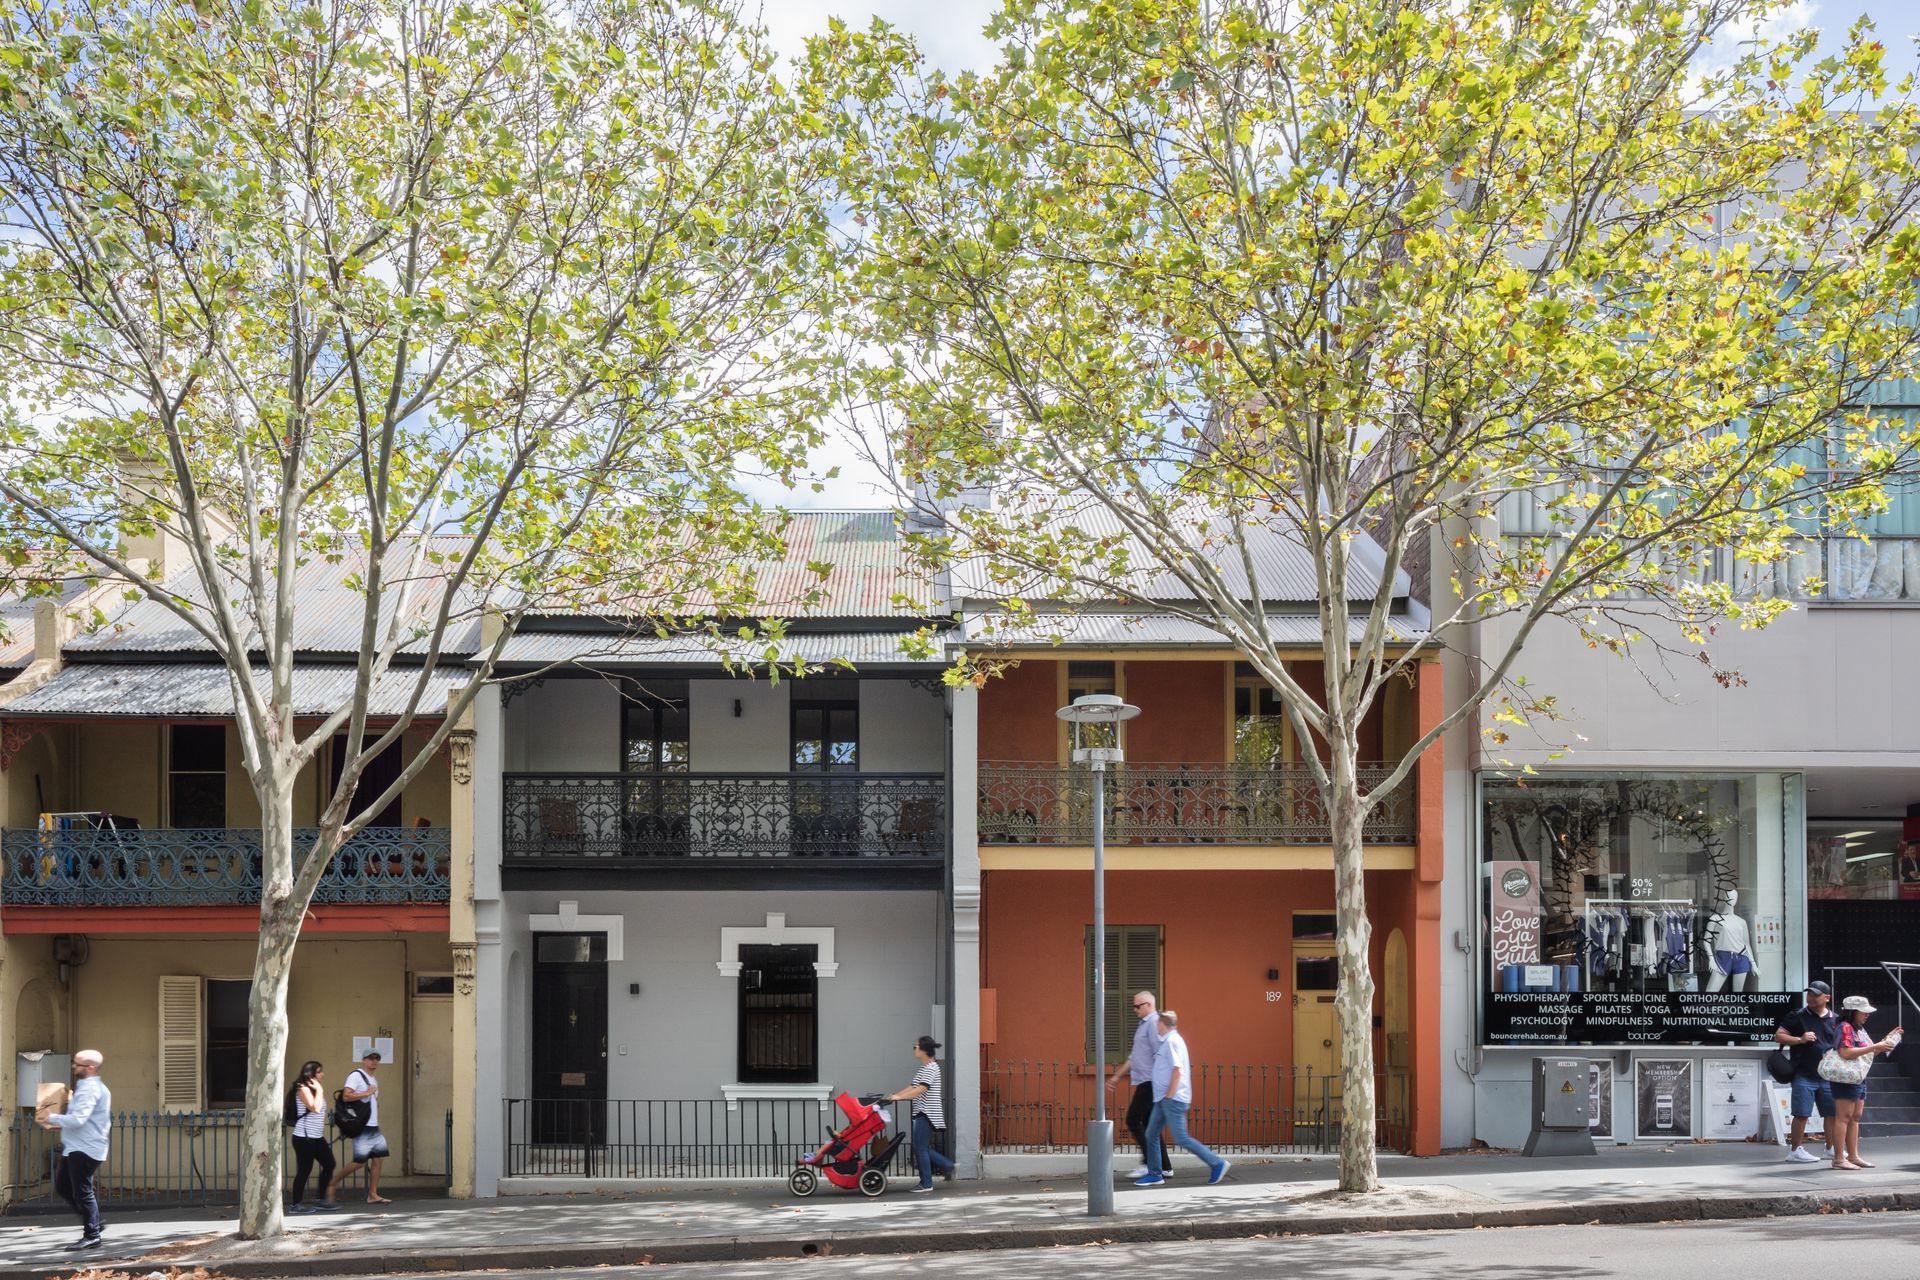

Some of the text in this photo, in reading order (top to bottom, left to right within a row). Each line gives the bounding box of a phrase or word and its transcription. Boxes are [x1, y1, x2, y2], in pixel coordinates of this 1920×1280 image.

[1631, 878, 1653, 887] 50%
[1632, 888, 1653, 897] OFF
[1493, 910, 1540, 933] Love
[1509, 931, 1534, 952] ya
[1493, 940, 1540, 970] Guts
[1265, 991, 1282, 1002] 189
[1494, 993, 1791, 1003] PHYSIOTHERAPY SPORTS MEDICINE ORTHOPAEDIC SURGERY
[1538, 1005, 1750, 1015] MASSAGE PILATES YOGA WHOLEFOODS
[1510, 1016, 1775, 1026] PSYCHOLOGY MINDFULNESS NUTRITIONAL MEDICINE
[1490, 1032, 1568, 1040] bouncerehab.com.au
[1627, 1030, 1668, 1041] bounce
[1750, 1033, 1759, 1041] 02
